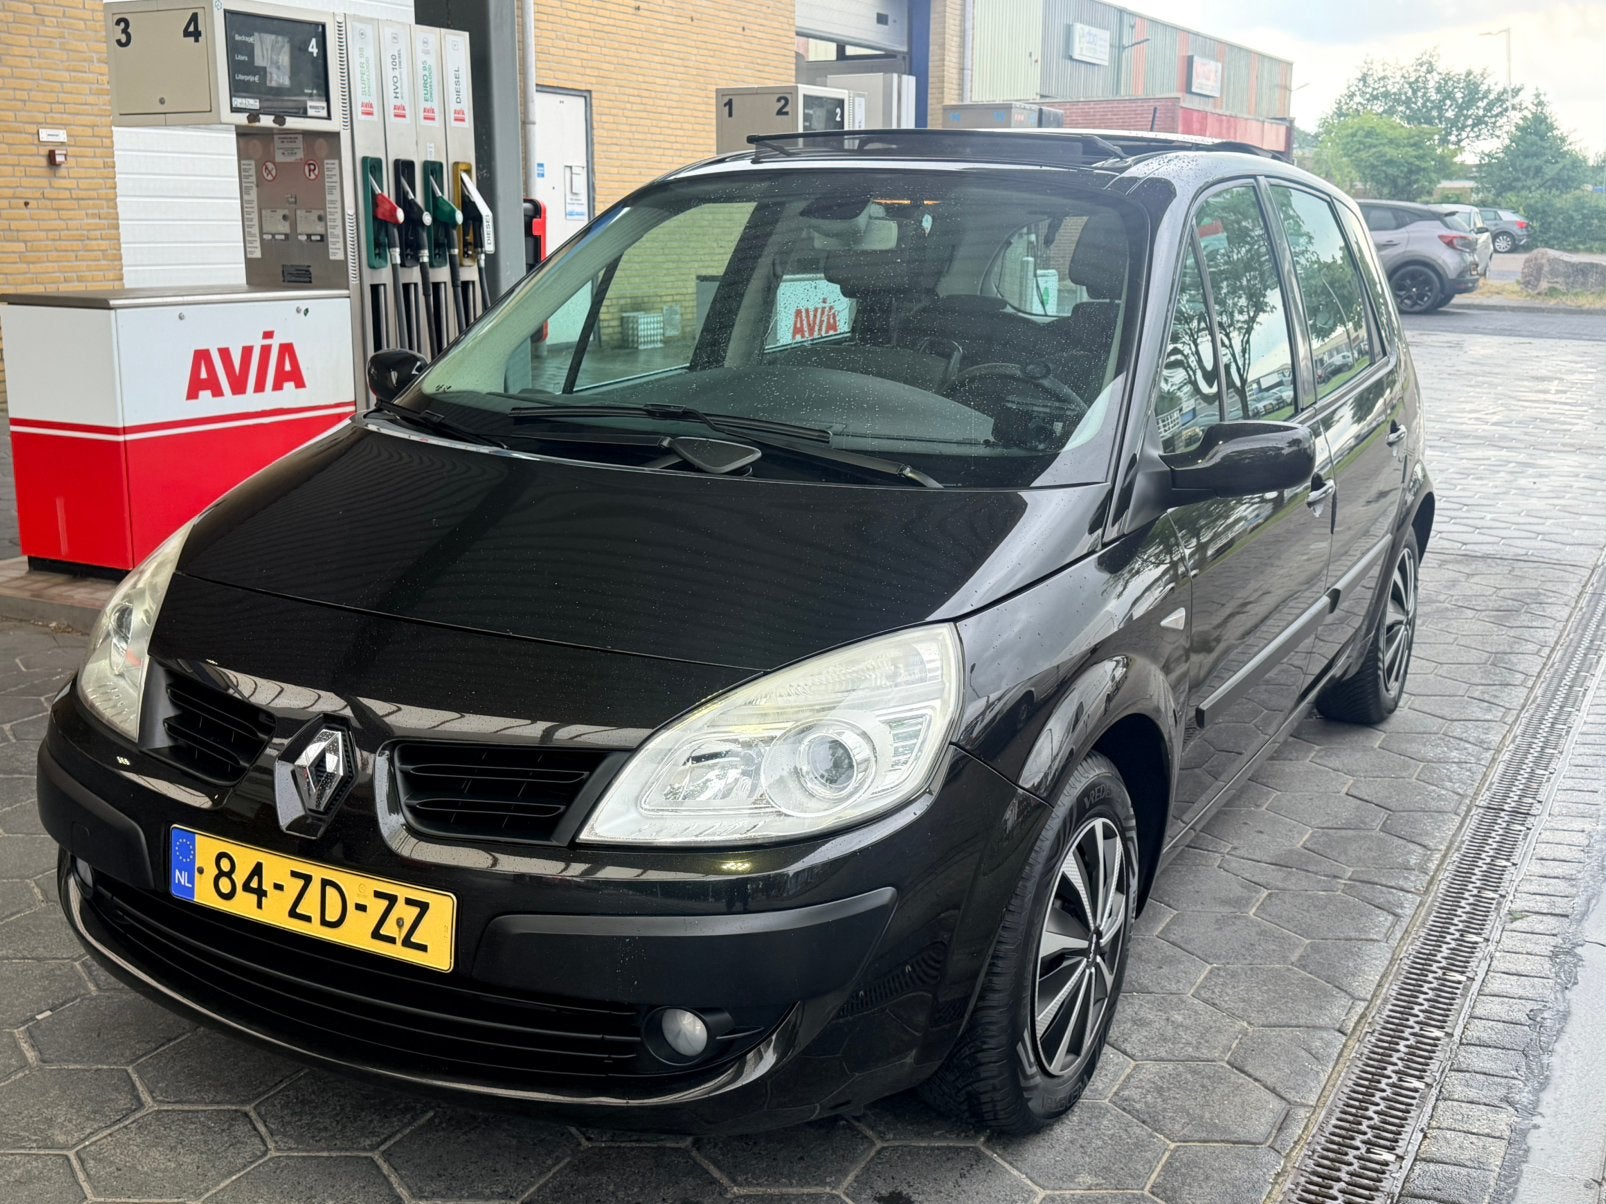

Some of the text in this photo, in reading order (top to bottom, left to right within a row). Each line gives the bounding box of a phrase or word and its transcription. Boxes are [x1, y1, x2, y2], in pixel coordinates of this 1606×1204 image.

[114, 17, 132, 48] 3
[182, 12, 202, 43] 4
[308, 37, 318, 57] 4
[390, 54, 398, 71] 100
[423, 60, 428, 72] 95
[454, 66, 462, 104] DIESEL
[723, 98, 734, 118] 1
[775, 95, 790, 117] 2
[835, 107, 842, 121] 2
[485, 214, 493, 246] DIESEL
[174, 868, 193, 889] NL
[212, 850, 431, 954] 84-ZD-ZZ
